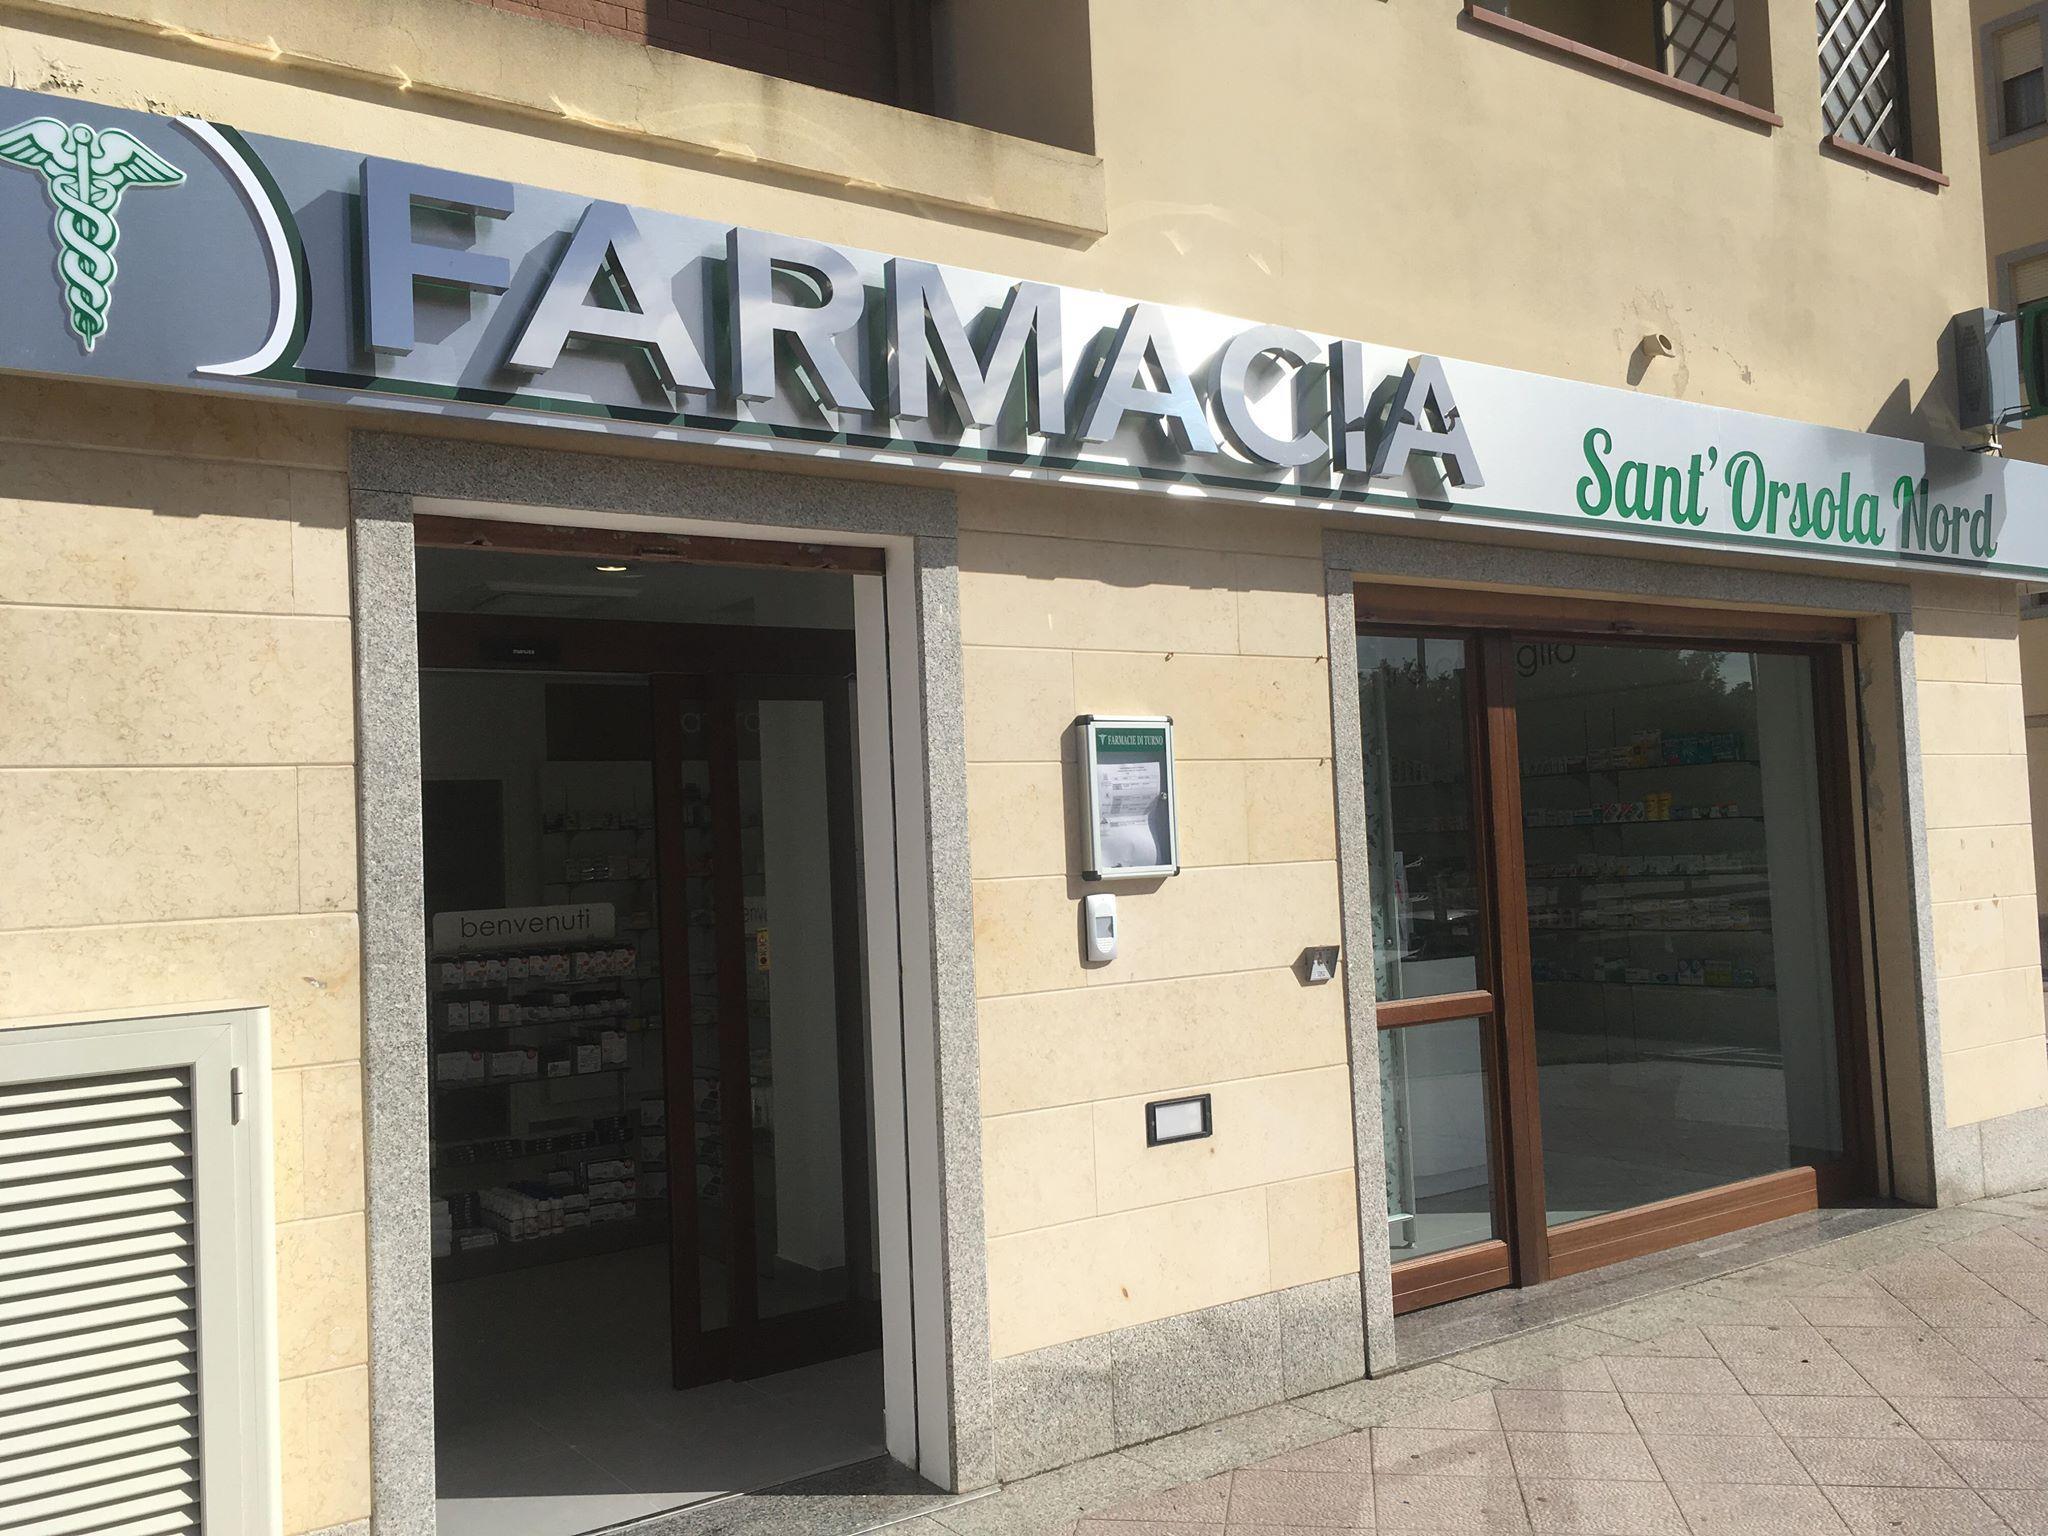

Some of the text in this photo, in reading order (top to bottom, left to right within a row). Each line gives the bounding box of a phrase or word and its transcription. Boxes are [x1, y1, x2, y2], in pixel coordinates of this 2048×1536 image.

[360, 157, 1485, 489] FARMACIA
[1893, 474, 1998, 559] Nord
[1107, 735, 1136, 745] FARMACIE
[1137, 735, 1144, 745] DI
[460, 908, 591, 938] benvenuti
